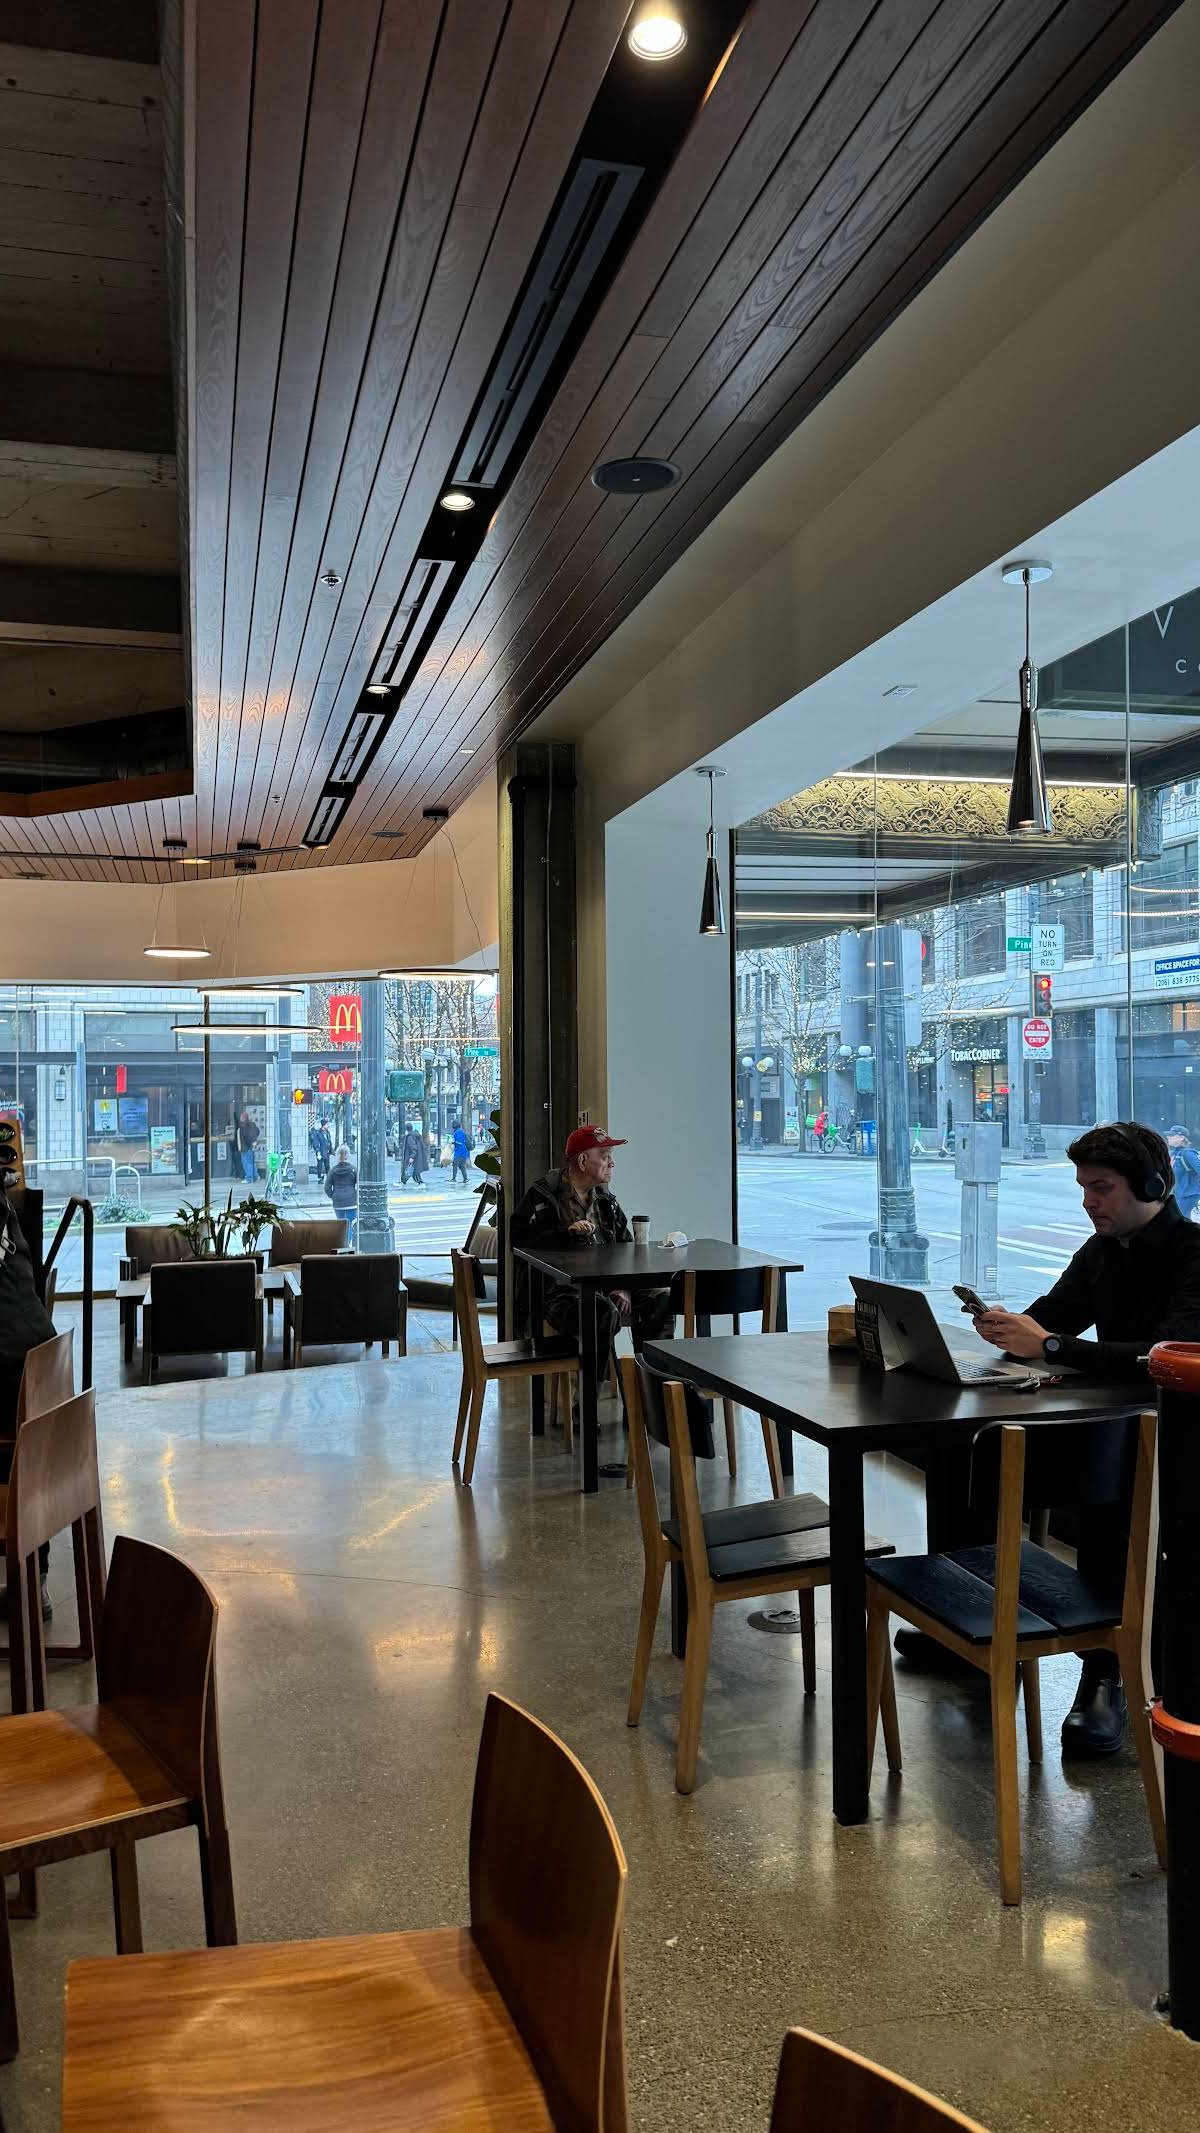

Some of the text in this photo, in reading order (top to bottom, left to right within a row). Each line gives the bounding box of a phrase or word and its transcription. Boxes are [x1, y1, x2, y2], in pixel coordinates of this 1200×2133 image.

[1040, 930, 1056, 938] NO
[1040, 958, 1055, 966] RED
[1156, 958, 1200, 971] OFFICE SPACE FOR
